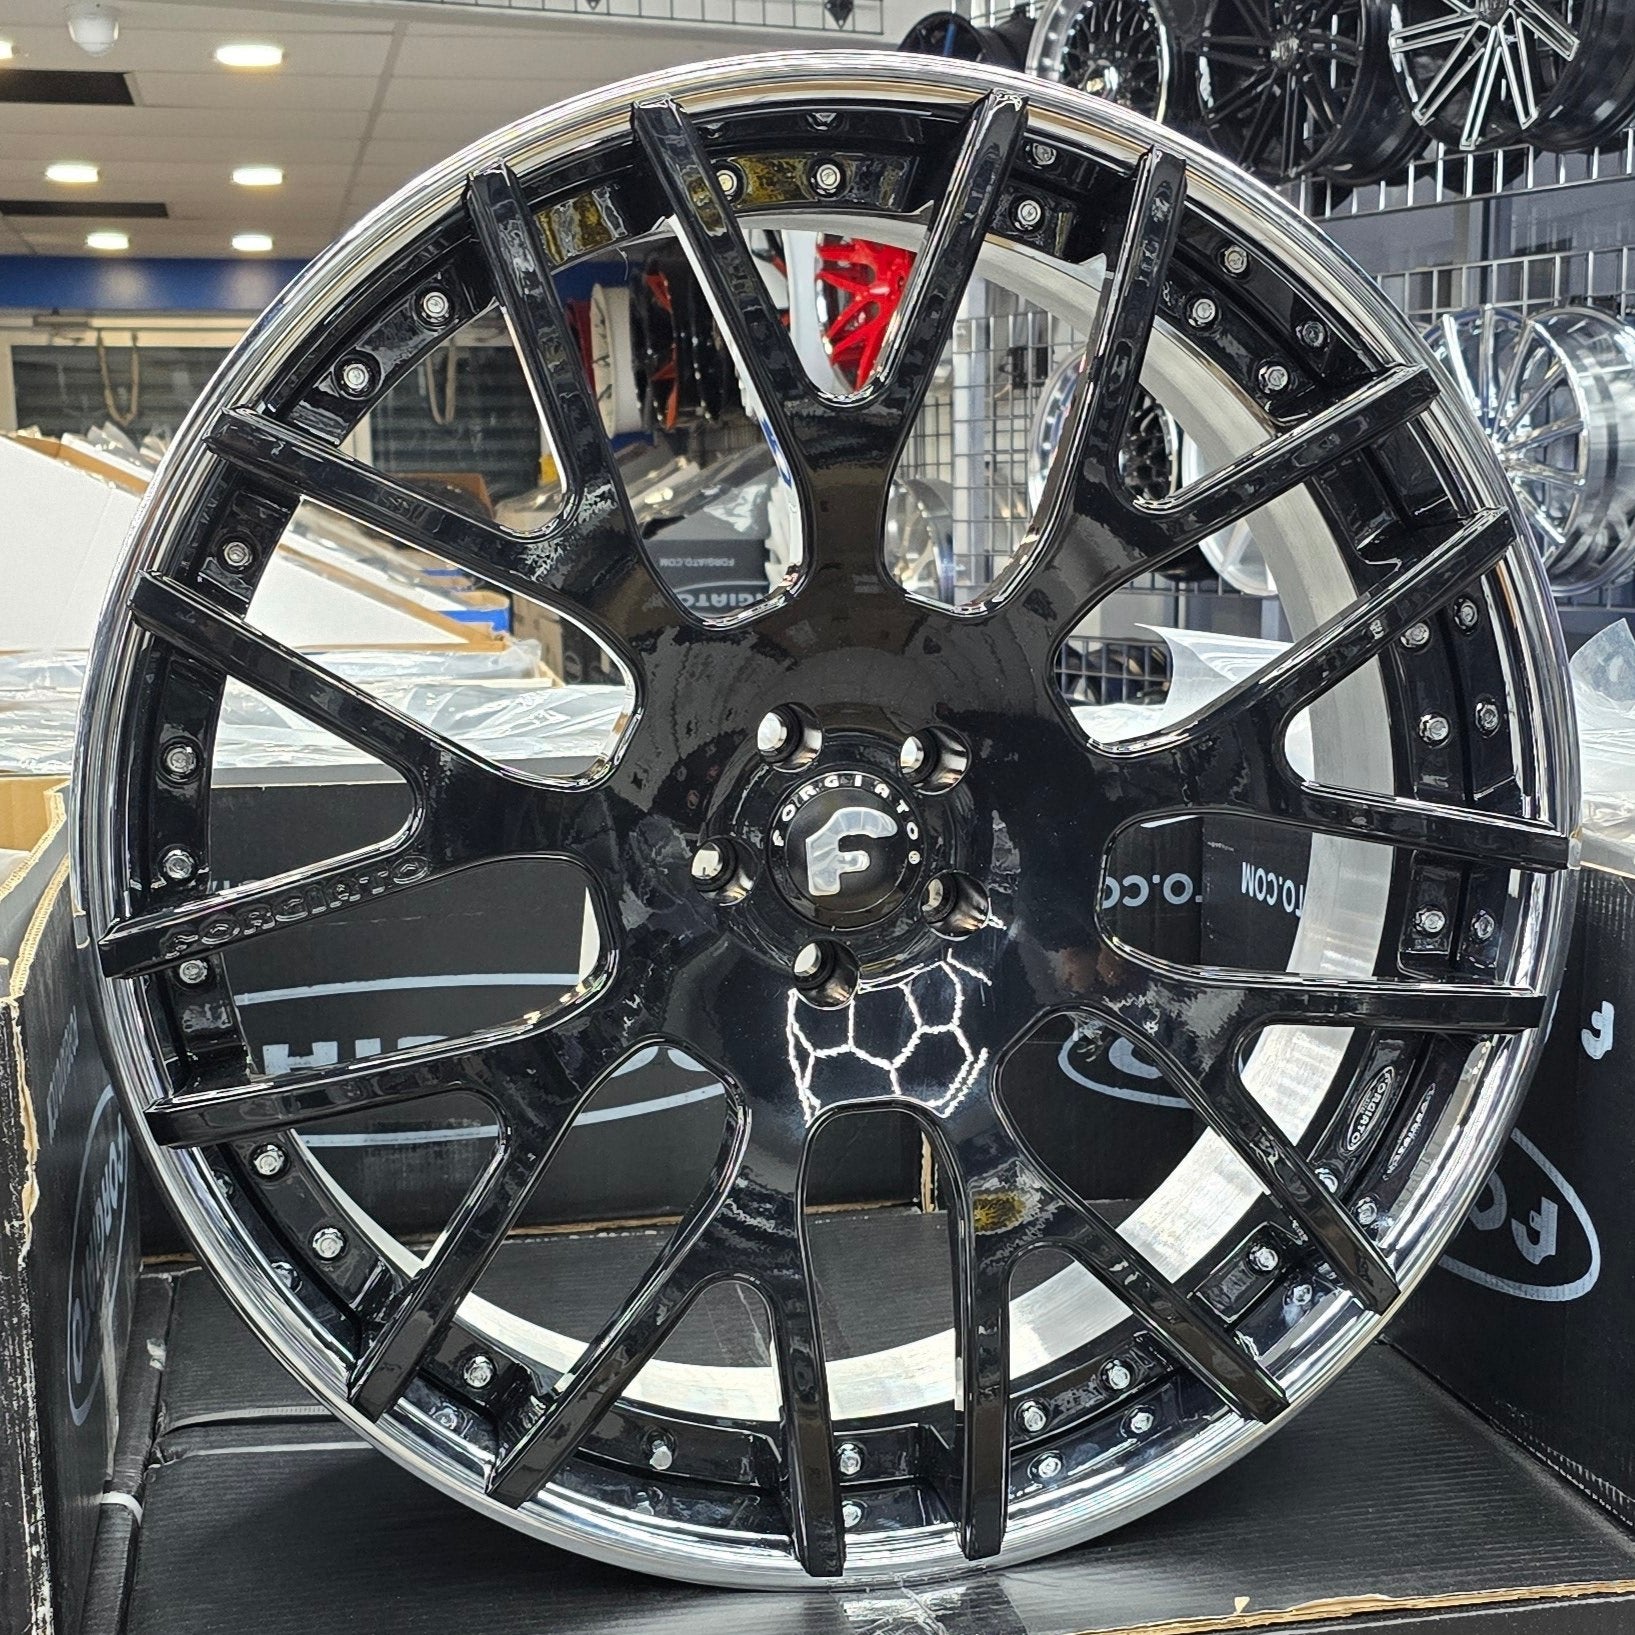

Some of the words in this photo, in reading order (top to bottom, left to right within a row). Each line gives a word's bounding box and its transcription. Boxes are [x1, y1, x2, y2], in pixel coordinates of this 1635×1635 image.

[659, 557, 735, 568] FORGIATO.COM
[772, 774, 919, 847] FORGIATO
[805, 806, 898, 896] F
[159, 854, 431, 960] FORGIATO
[1351, 1071, 1392, 1145] FORGIATO
